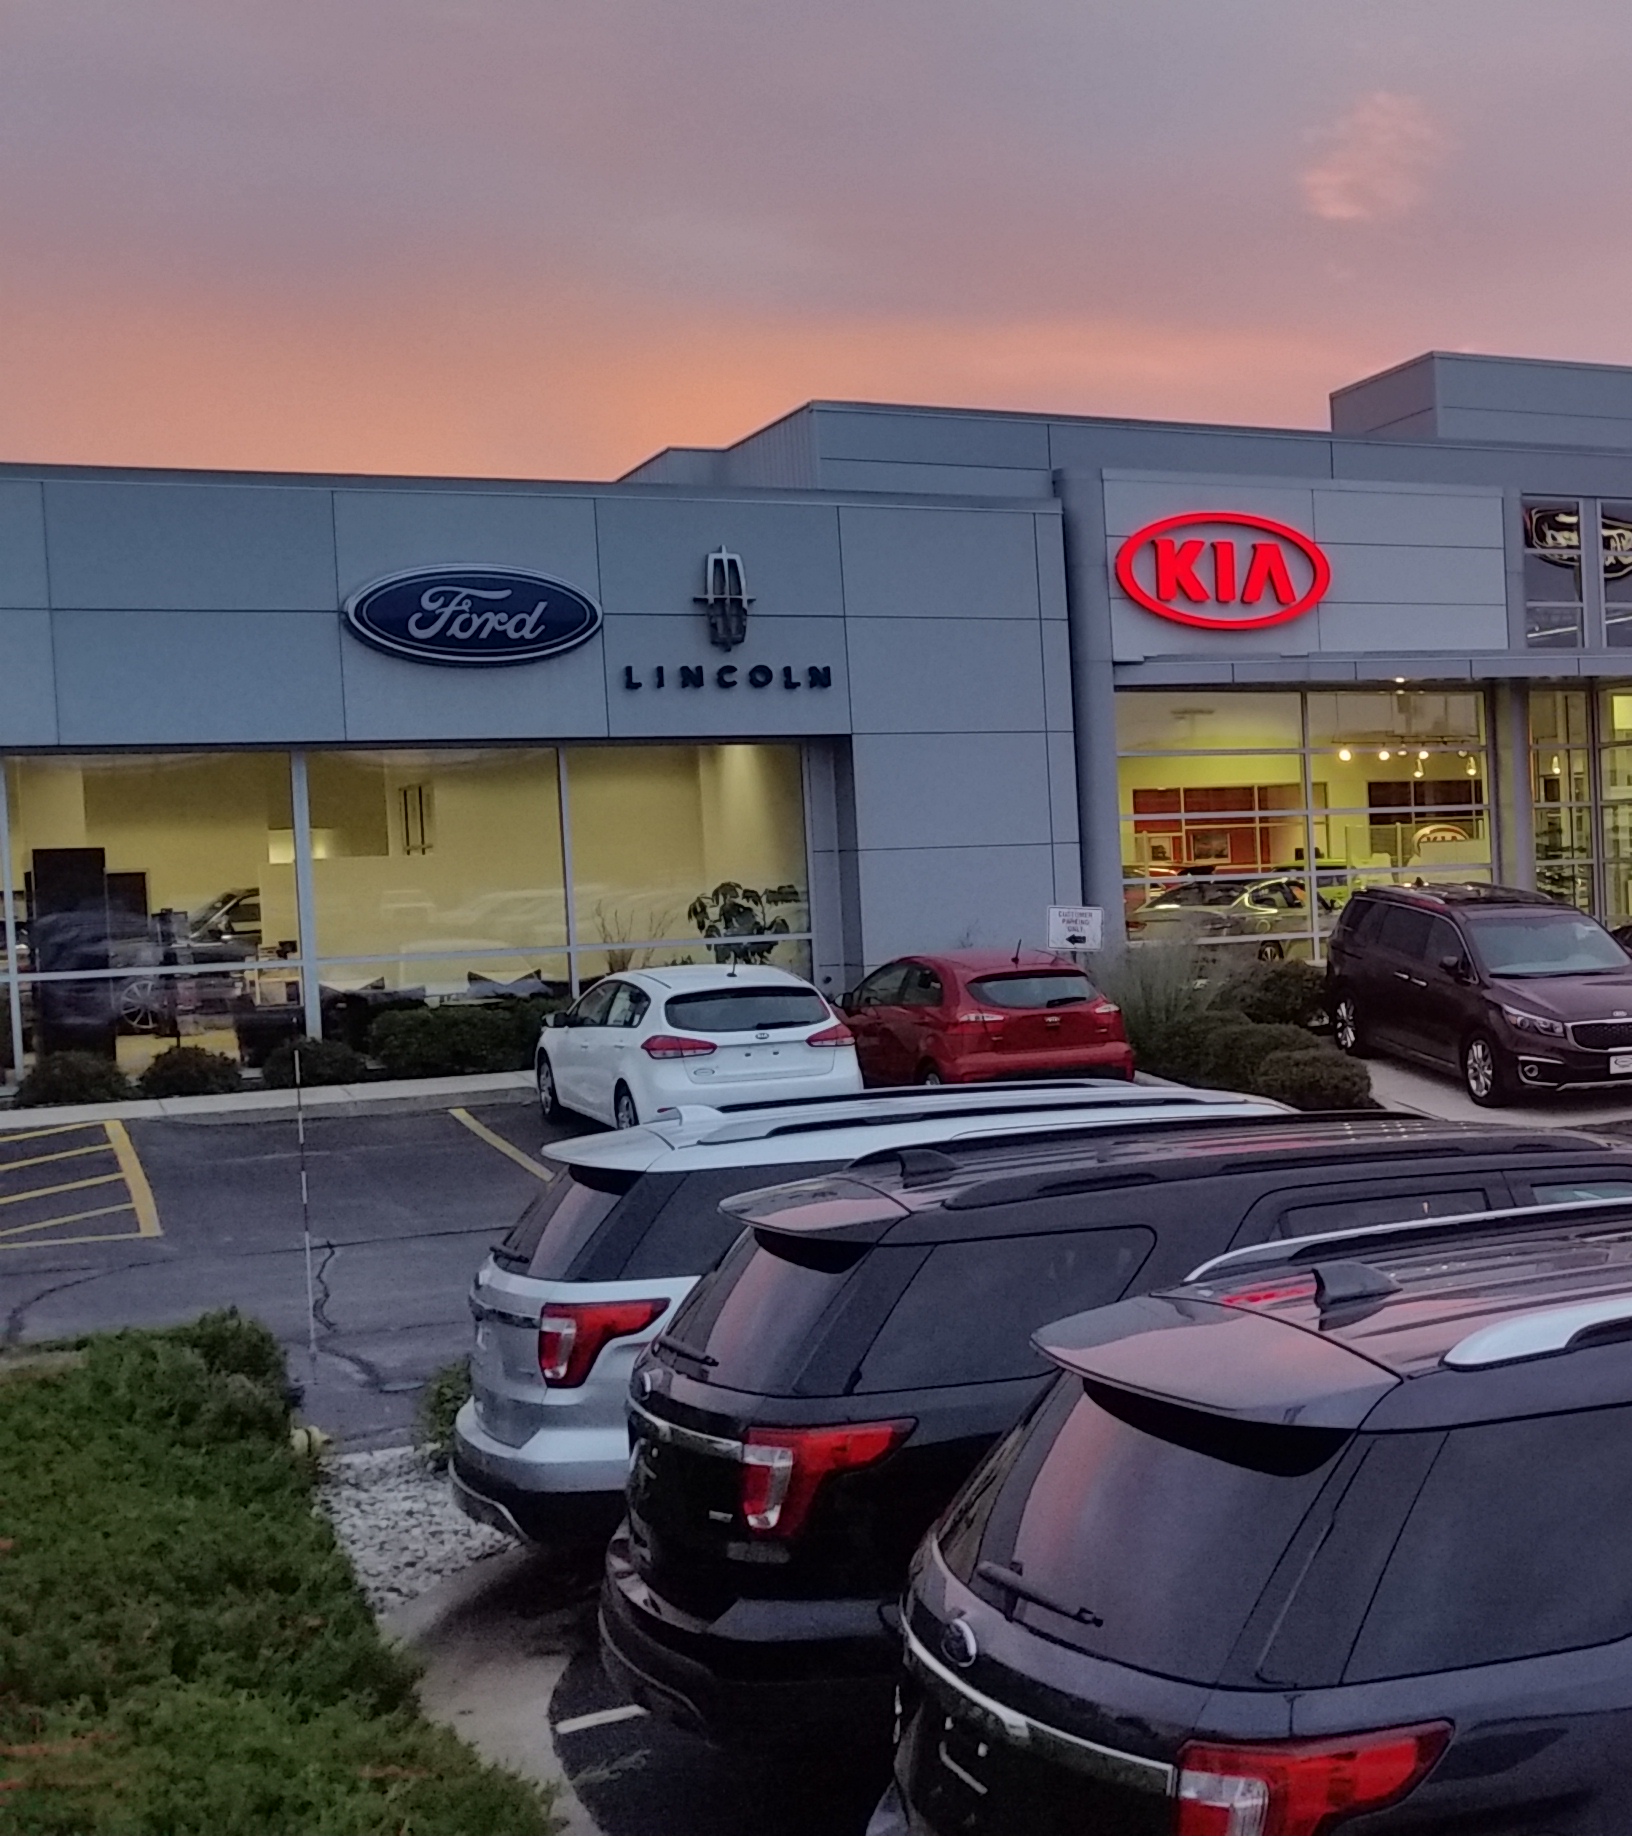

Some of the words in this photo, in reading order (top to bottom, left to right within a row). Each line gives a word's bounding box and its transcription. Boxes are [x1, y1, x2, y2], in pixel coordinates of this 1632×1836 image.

[1151, 538, 1297, 605] KIA
[407, 585, 548, 641] Ford
[623, 664, 833, 690] LINCOLN
[1061, 918, 1090, 926] PARKING
